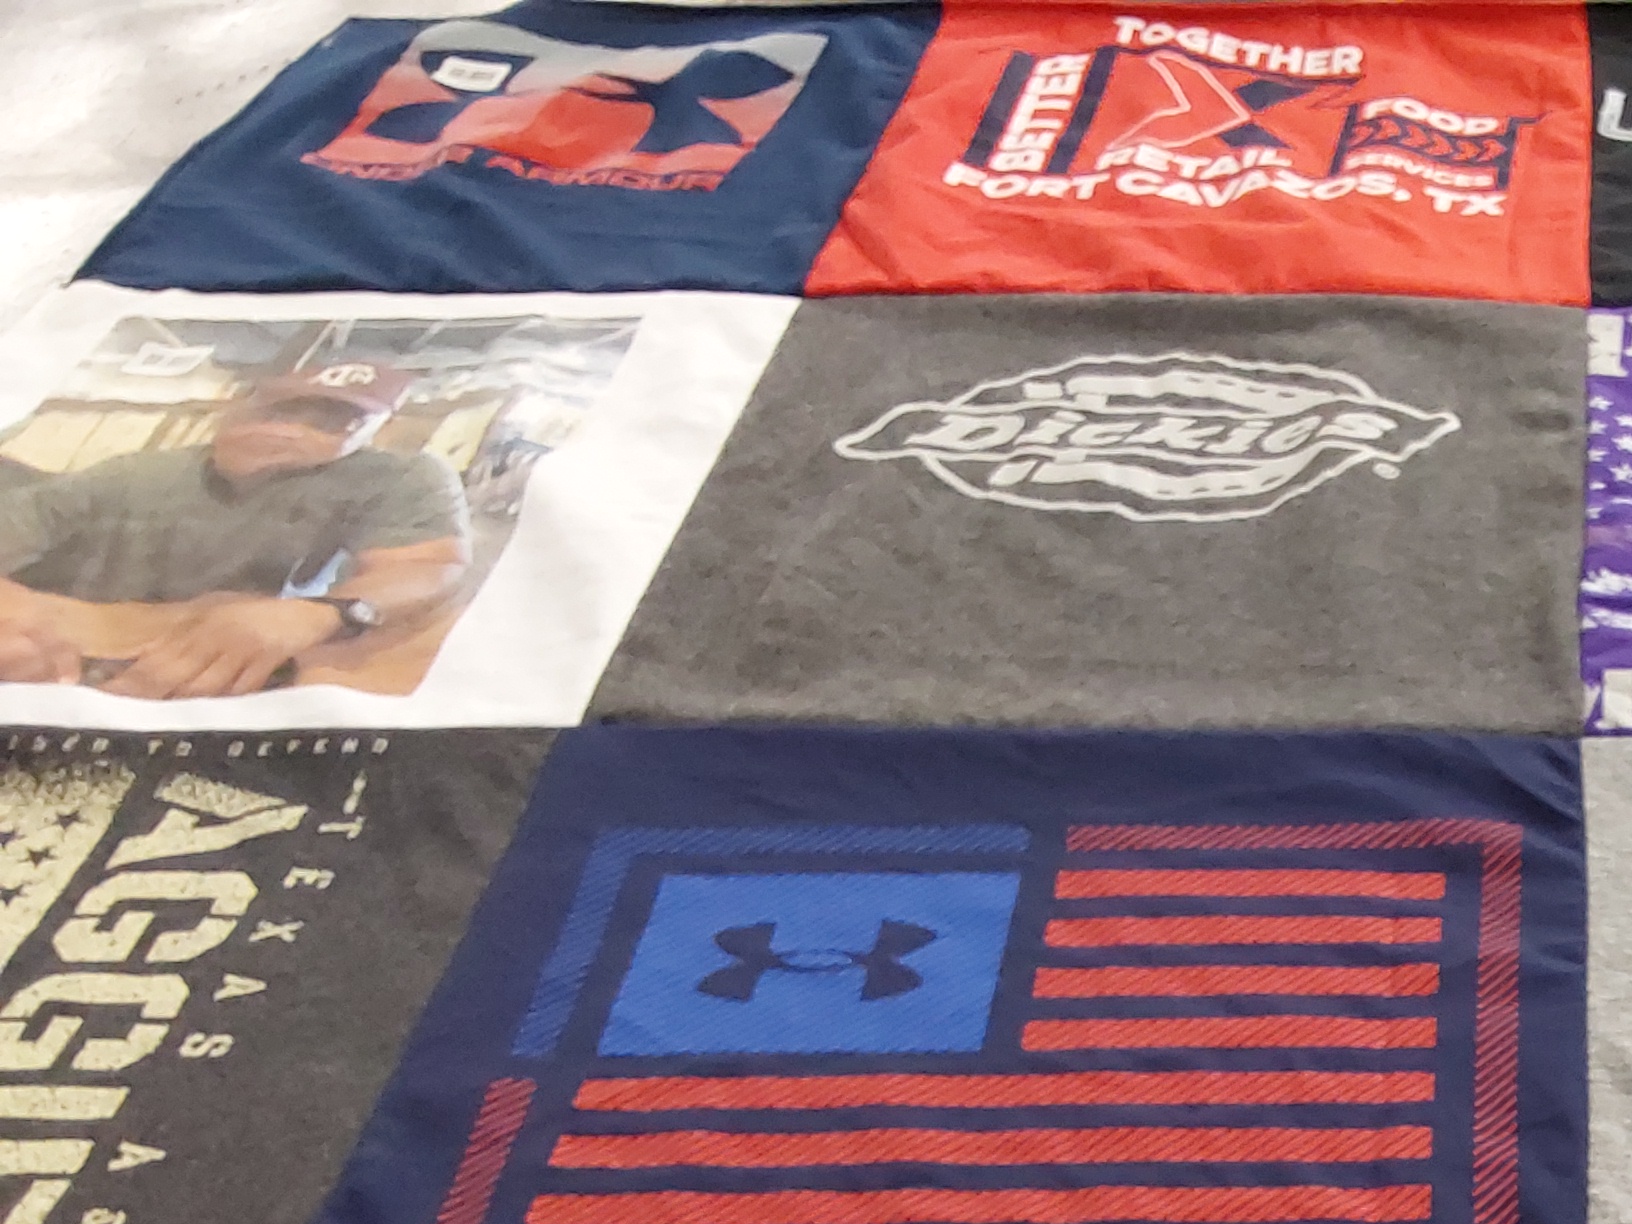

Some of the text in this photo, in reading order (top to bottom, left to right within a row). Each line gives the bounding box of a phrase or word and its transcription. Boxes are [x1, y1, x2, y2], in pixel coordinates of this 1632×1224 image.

[1114, 15, 1364, 76] TOGETHER
[989, 53, 1091, 172] BETTER
[1364, 97, 1499, 135] FOOD
[943, 161, 1508, 216] FORT CAVAZOS, TX
[1096, 143, 1292, 180] RETAIL
[178, 813, 367, 1058] TEXAS
